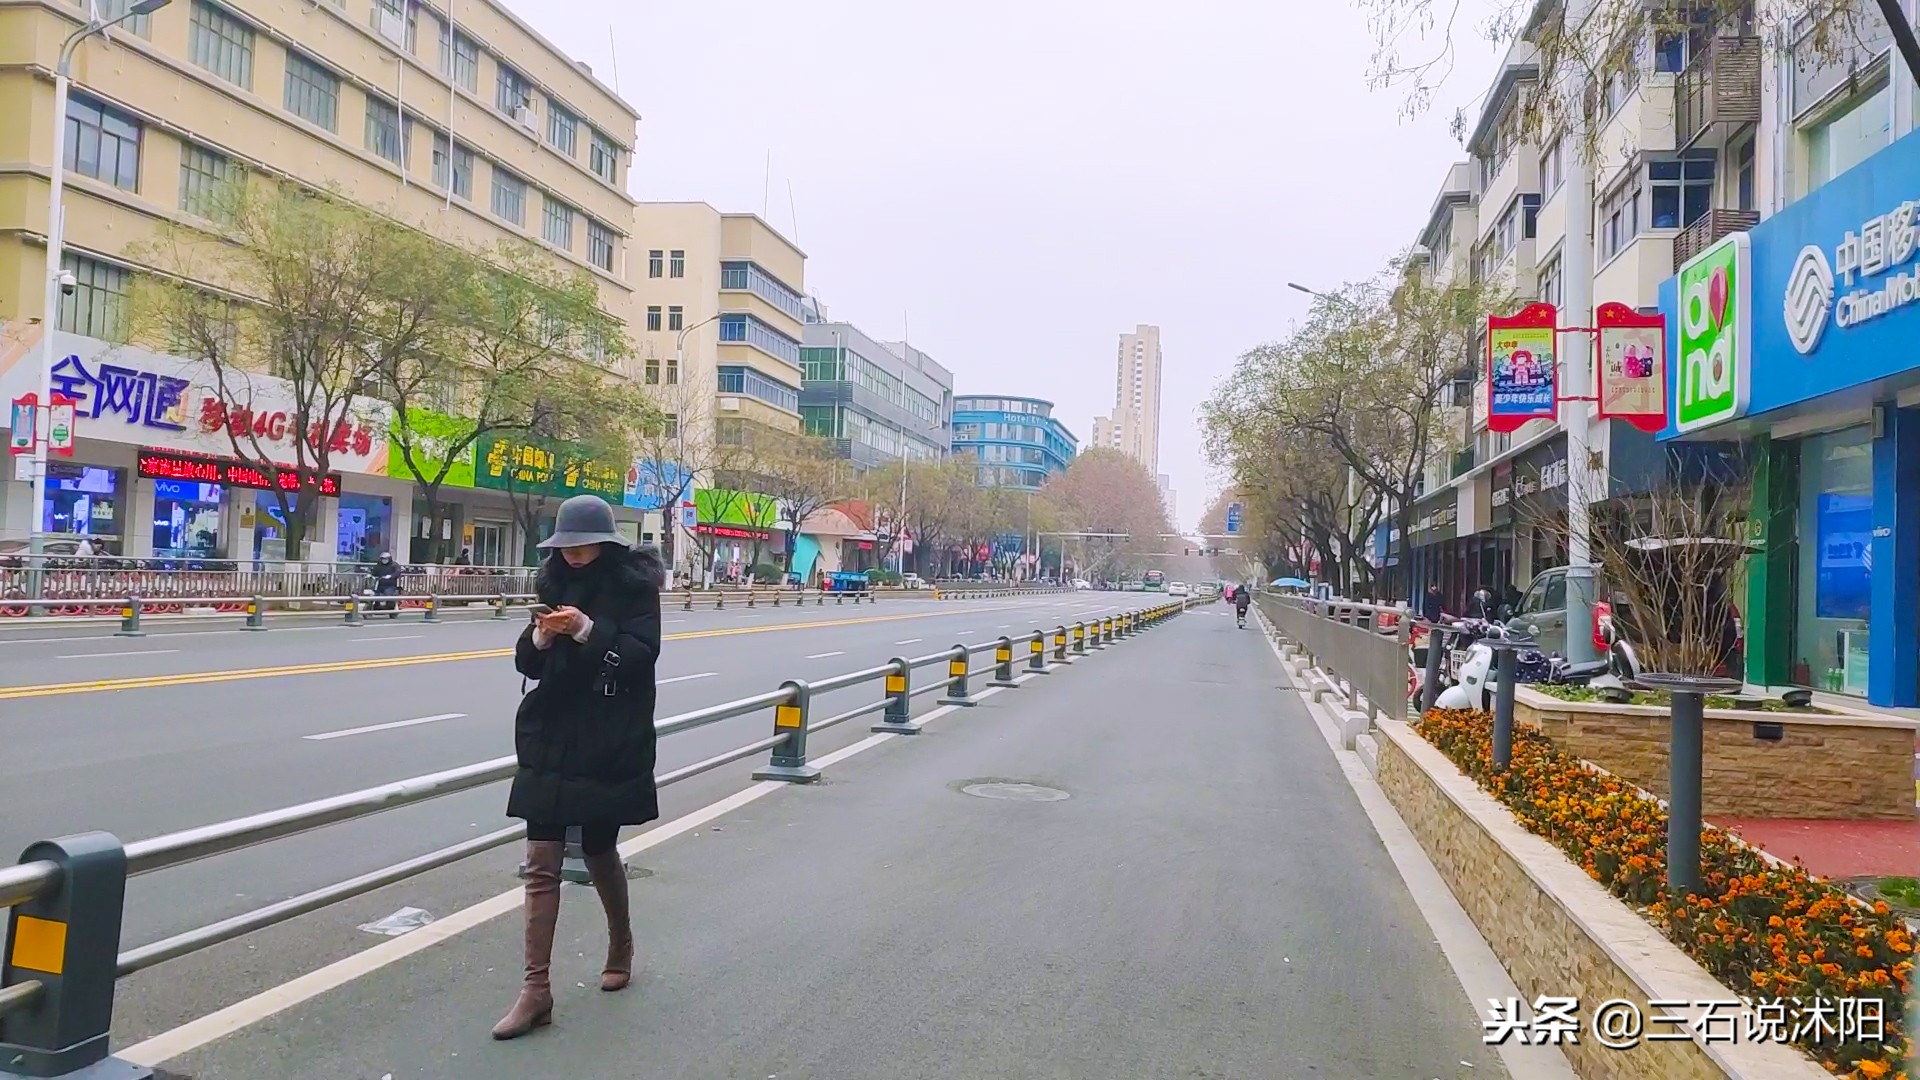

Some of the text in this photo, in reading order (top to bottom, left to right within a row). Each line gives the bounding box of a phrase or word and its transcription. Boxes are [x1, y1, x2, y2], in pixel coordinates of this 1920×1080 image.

[1836, 200, 1920, 287] 中国移
[50, 354, 190, 431] 全网通
[155, 481, 181, 494] vivo
